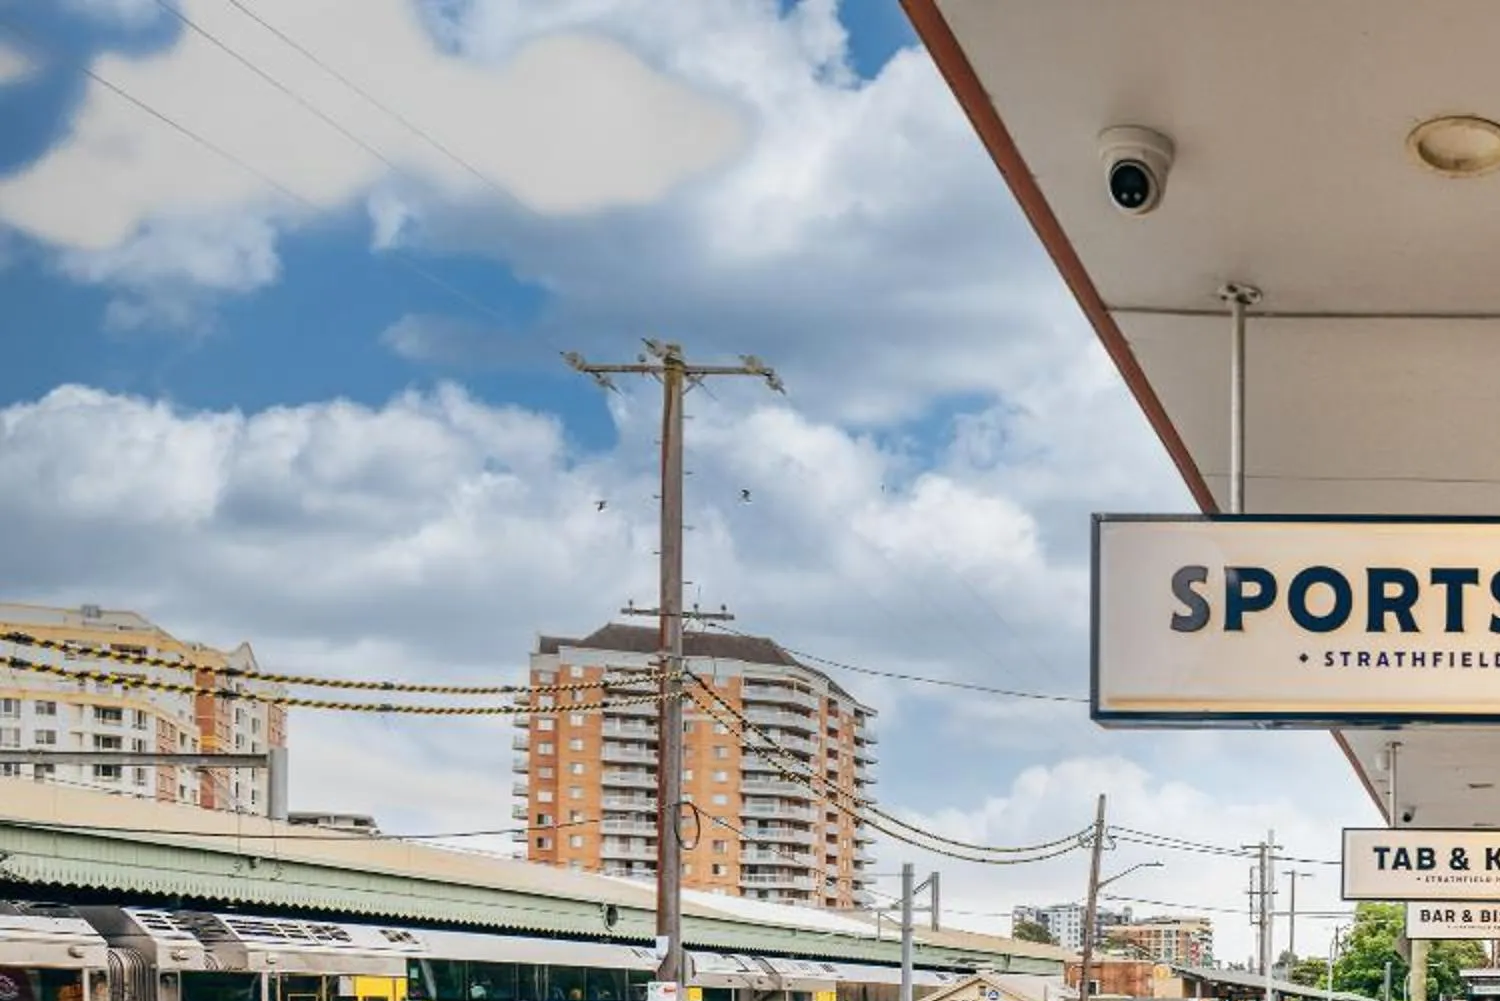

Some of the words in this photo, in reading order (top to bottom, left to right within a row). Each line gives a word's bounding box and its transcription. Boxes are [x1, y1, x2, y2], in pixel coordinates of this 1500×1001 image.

[1372, 846, 1437, 871] TAB
[1448, 847, 1471, 871] &
[1420, 909, 1456, 923] BAR
[1461, 909, 1473, 923] &
